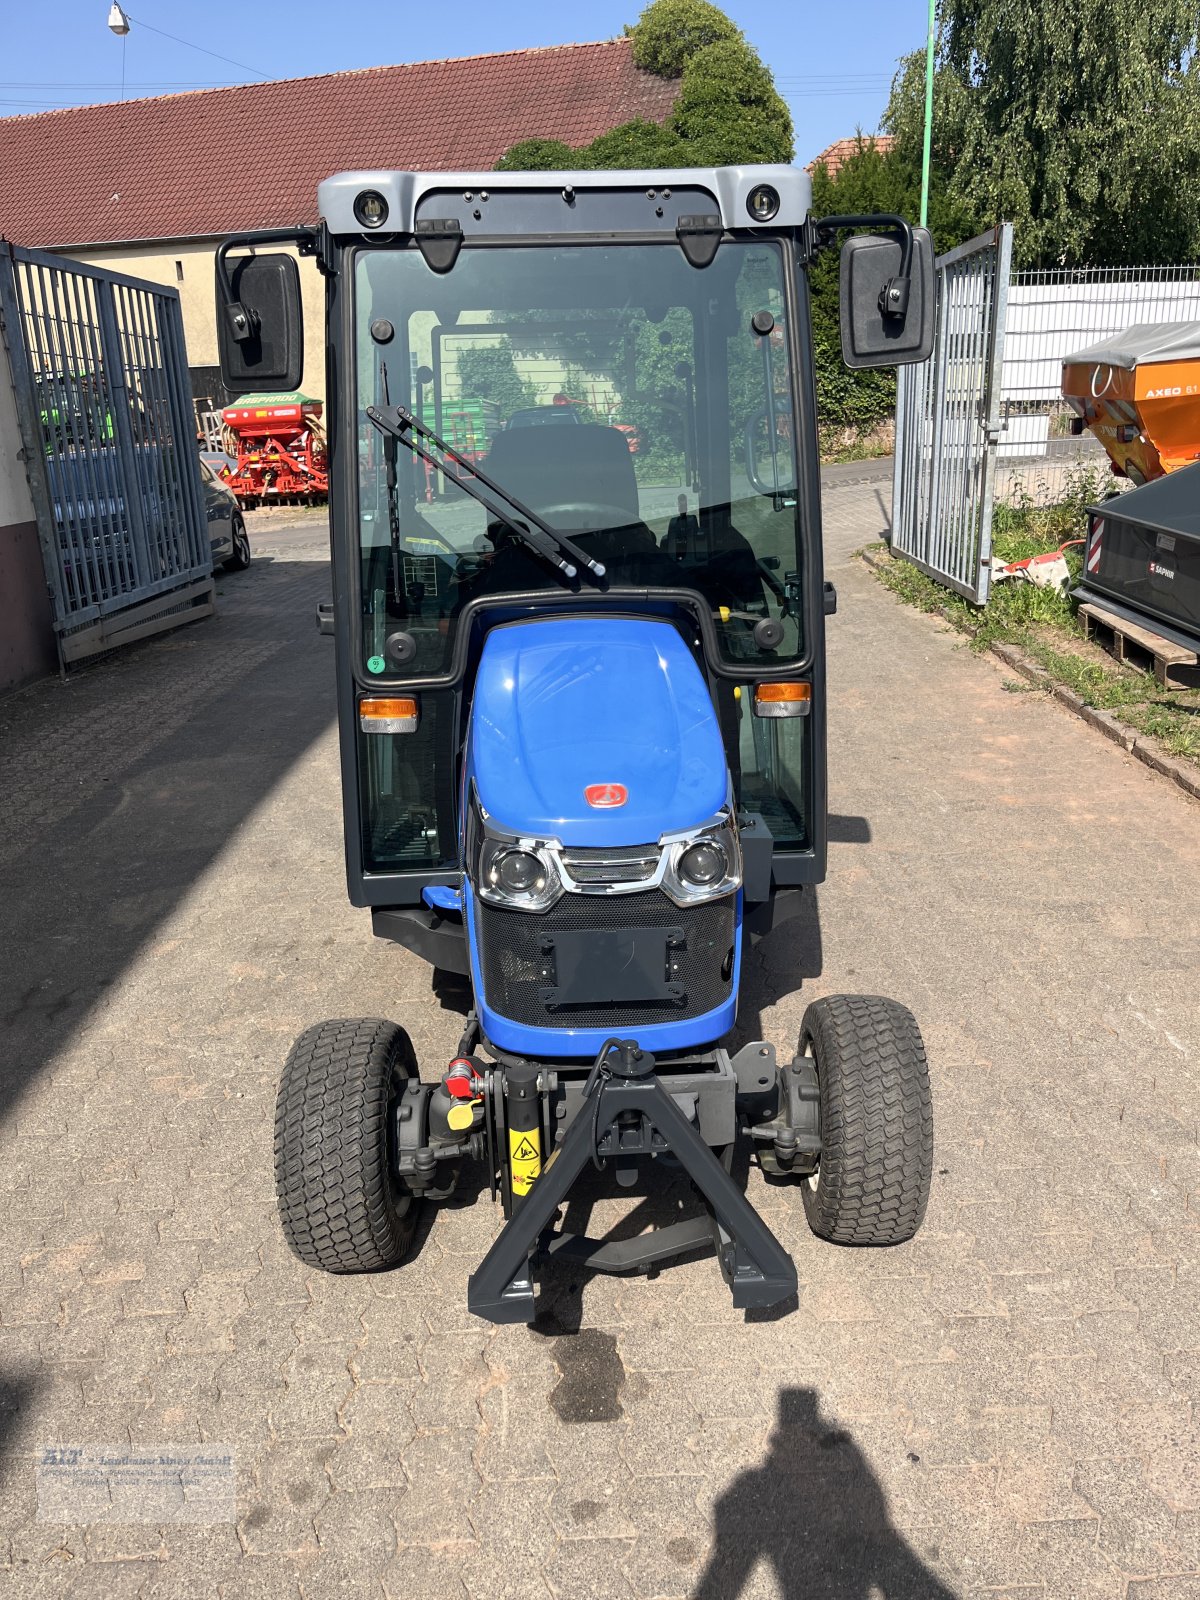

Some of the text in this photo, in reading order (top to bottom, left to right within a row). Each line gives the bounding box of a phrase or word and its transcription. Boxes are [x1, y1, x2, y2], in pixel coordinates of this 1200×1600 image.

[1146, 387, 1181, 398] AXEO
[234, 394, 298, 405] GASPARDO
[1155, 565, 1175, 580] SAPHIR
